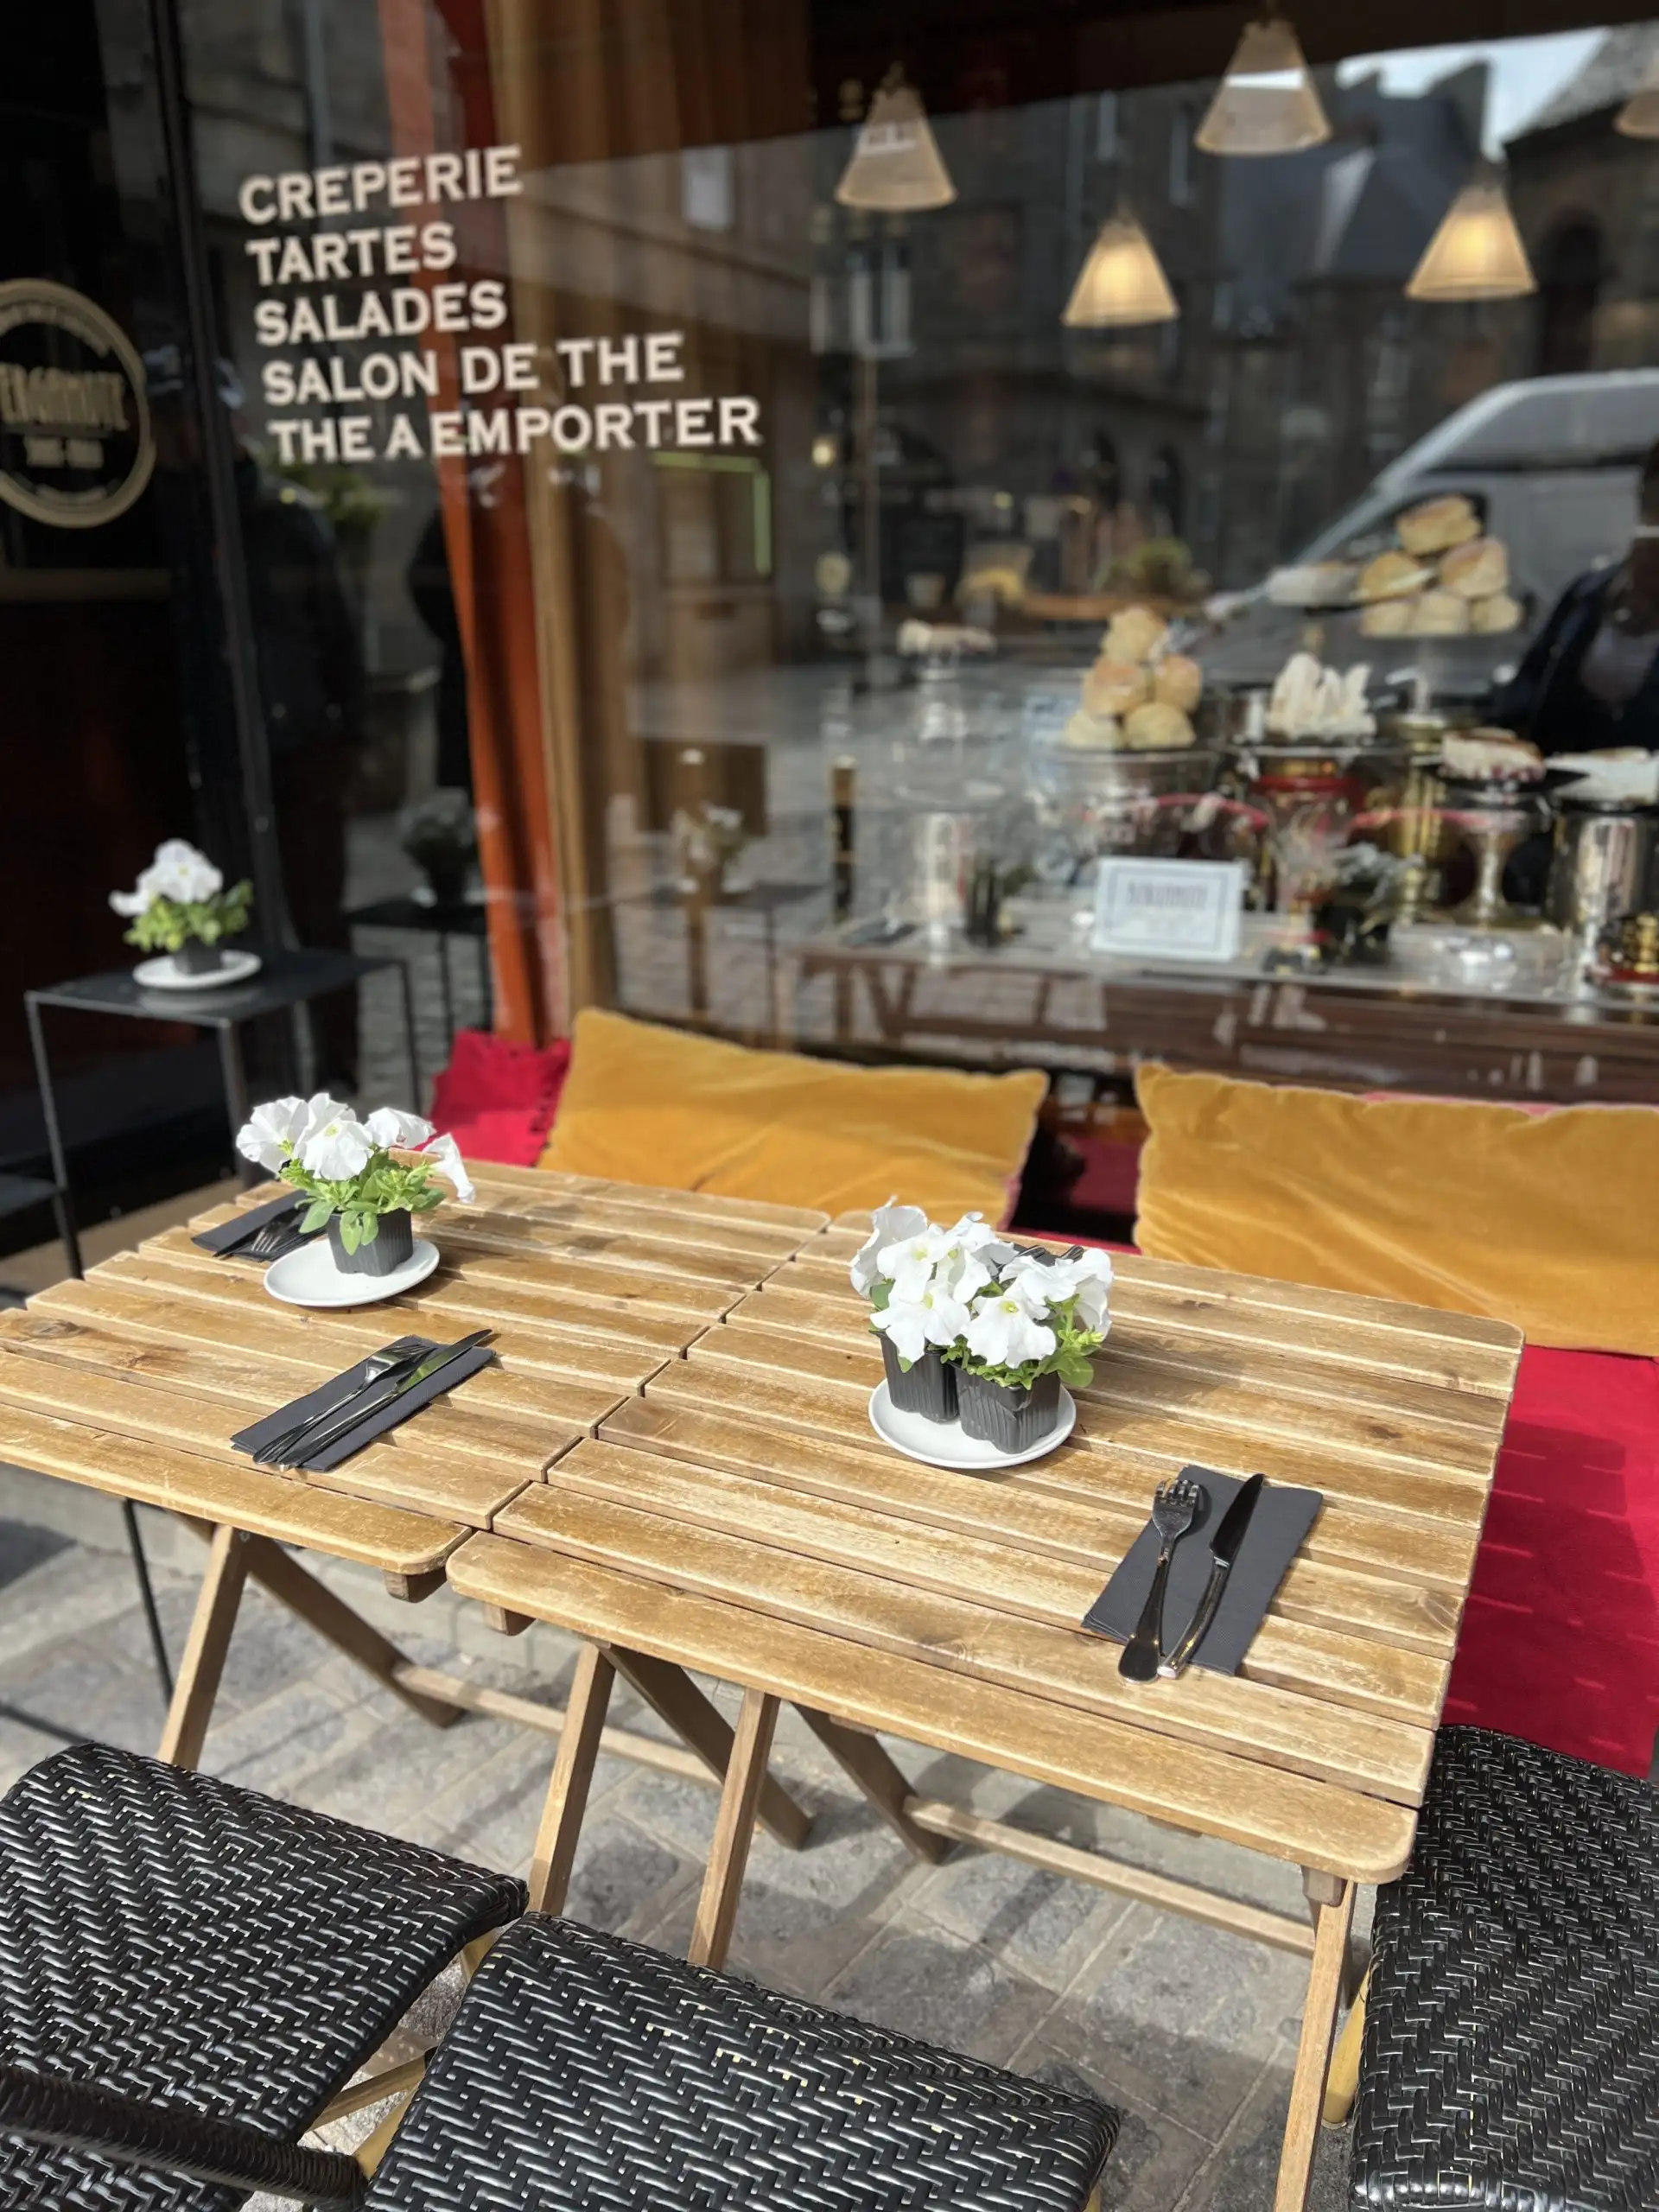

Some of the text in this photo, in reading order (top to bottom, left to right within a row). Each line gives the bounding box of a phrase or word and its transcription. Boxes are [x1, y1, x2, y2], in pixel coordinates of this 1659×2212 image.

[238, 143, 524, 224] CREPERIE
[245, 221, 457, 286] TARTES
[253, 280, 507, 346] SALADES
[262, 331, 684, 406] SALON DE THE
[268, 395, 762, 464] THE A EMPORTER
